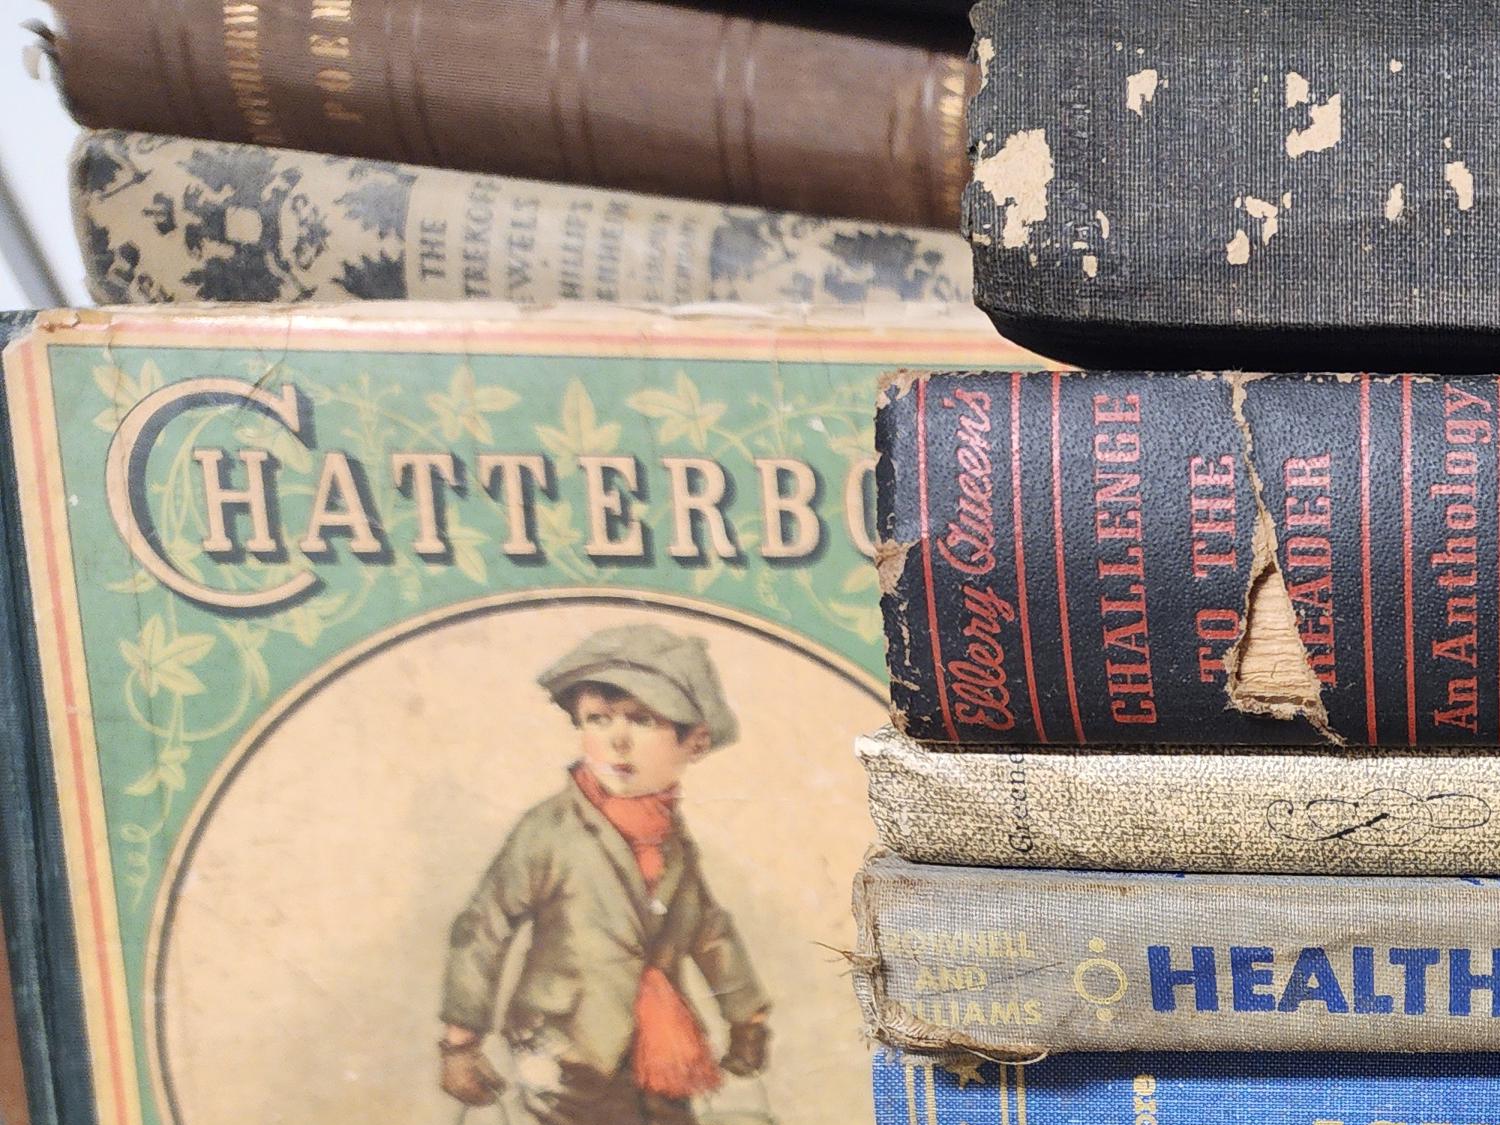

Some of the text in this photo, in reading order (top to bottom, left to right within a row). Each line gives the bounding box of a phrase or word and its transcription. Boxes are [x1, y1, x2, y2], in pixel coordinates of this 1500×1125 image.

[419, 219, 447, 280] THE
[462, 179, 501, 299] TREKOFF
[503, 197, 541, 302] EWELS
[558, 200, 594, 299] HILLIPS
[104, 376, 882, 617] CHATTERBO
[936, 385, 1017, 731] Ellery Queen's
[1093, 392, 1160, 726] CHALLENGE
[1188, 453, 1242, 684] TO THE
[1282, 453, 1337, 687] READER
[1430, 383, 1492, 734] An Anthology
[914, 963, 989, 993] AND
